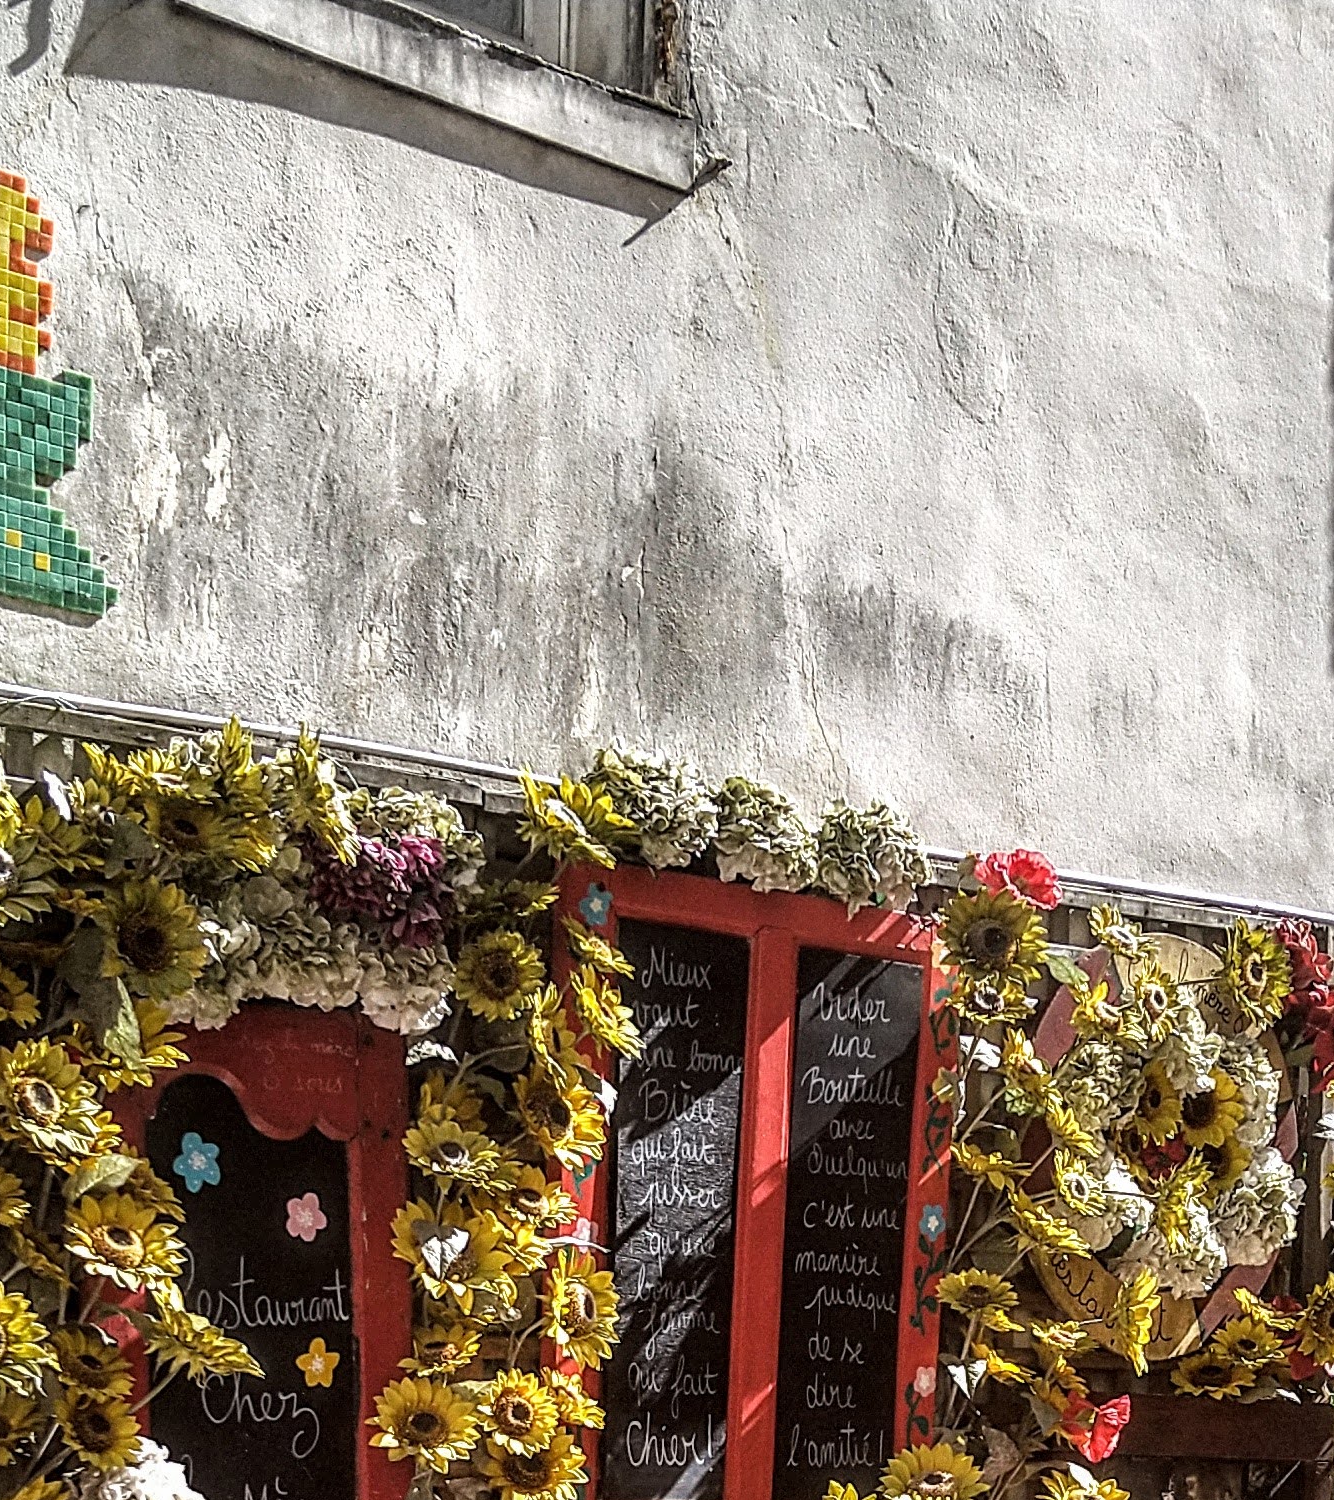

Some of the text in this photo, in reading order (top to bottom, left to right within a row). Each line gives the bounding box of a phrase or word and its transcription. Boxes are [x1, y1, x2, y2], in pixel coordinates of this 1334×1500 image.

[641, 945, 712, 990] Mieux
[632, 993, 699, 1028] vaut
[812, 981, 891, 1023] Vider
[686, 1039, 745, 1073] bonne
[827, 1033, 877, 1059] une
[800, 1065, 906, 1108] Bouteille
[828, 1118, 875, 1140] avec
[638, 1179, 721, 1223] pisser
[861, 1207, 901, 1230] une
[794, 1243, 882, 1277] manière
[633, 1262, 702, 1303] bonne
[804, 1282, 897, 1331] pudique
[643, 1302, 721, 1361] femme
[809, 1333, 865, 1364] de se
[671, 1354, 719, 1419] fait
[806, 1373, 857, 1409] dire
